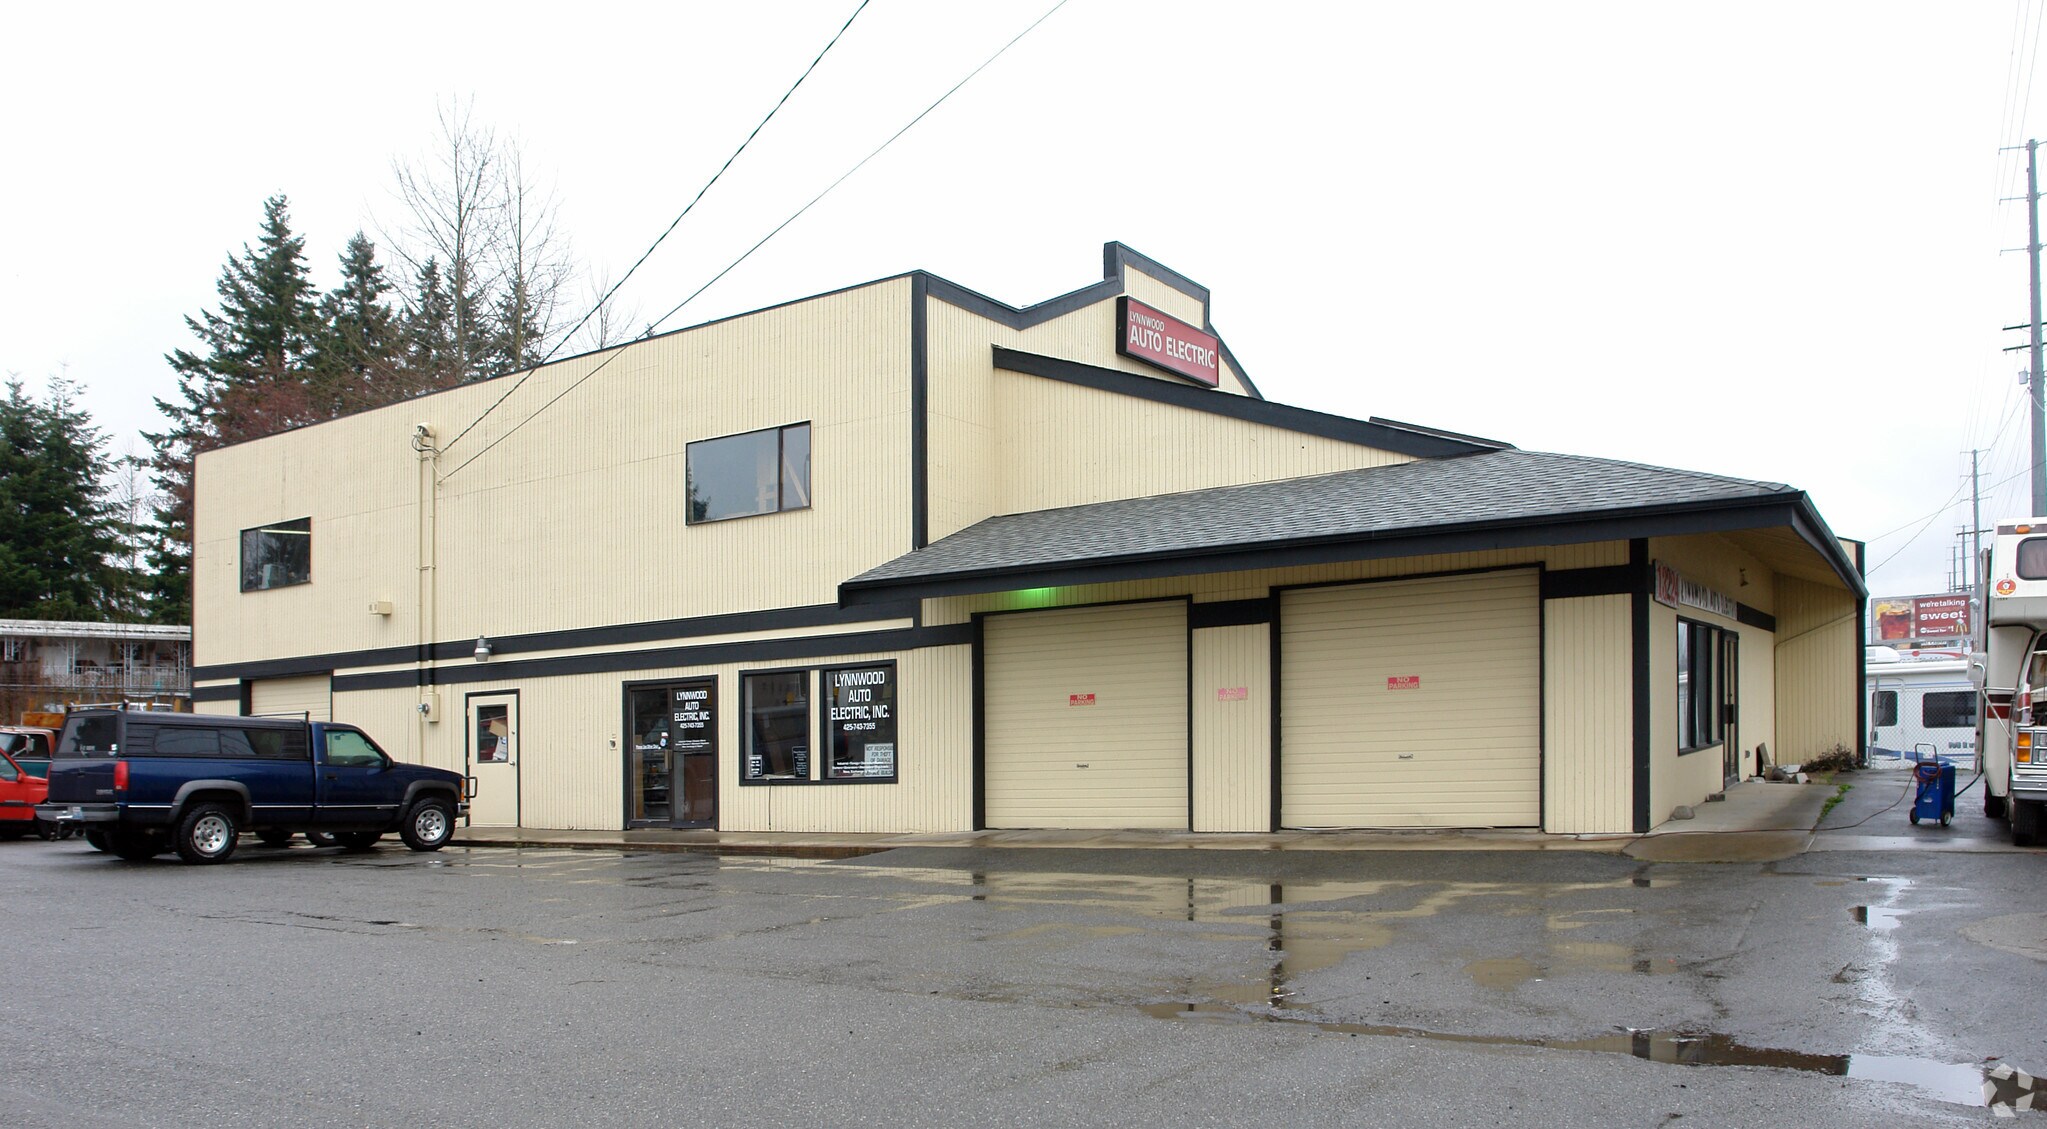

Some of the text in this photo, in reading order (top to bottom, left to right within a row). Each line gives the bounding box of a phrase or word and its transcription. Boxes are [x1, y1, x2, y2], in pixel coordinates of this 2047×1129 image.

[1129, 310, 1165, 332] LYNNWOOD
[1129, 325, 1215, 369] AUTO ELECTRIC
[1939, 599, 1966, 607] talking
[1920, 610, 1967, 621] sweet.
[834, 671, 885, 687] LYNNWOOD
[1388, 682, 1419, 690] PARKING
[676, 690, 708, 701] LYNNWOOD
[848, 688, 872, 703] AUTO
[684, 701, 700, 711] AUTO
[699, 711, 710, 720] INC.
[830, 704, 890, 720] ELECTRIC, INC.
[843, 722, 876, 731] 425-743-7355
